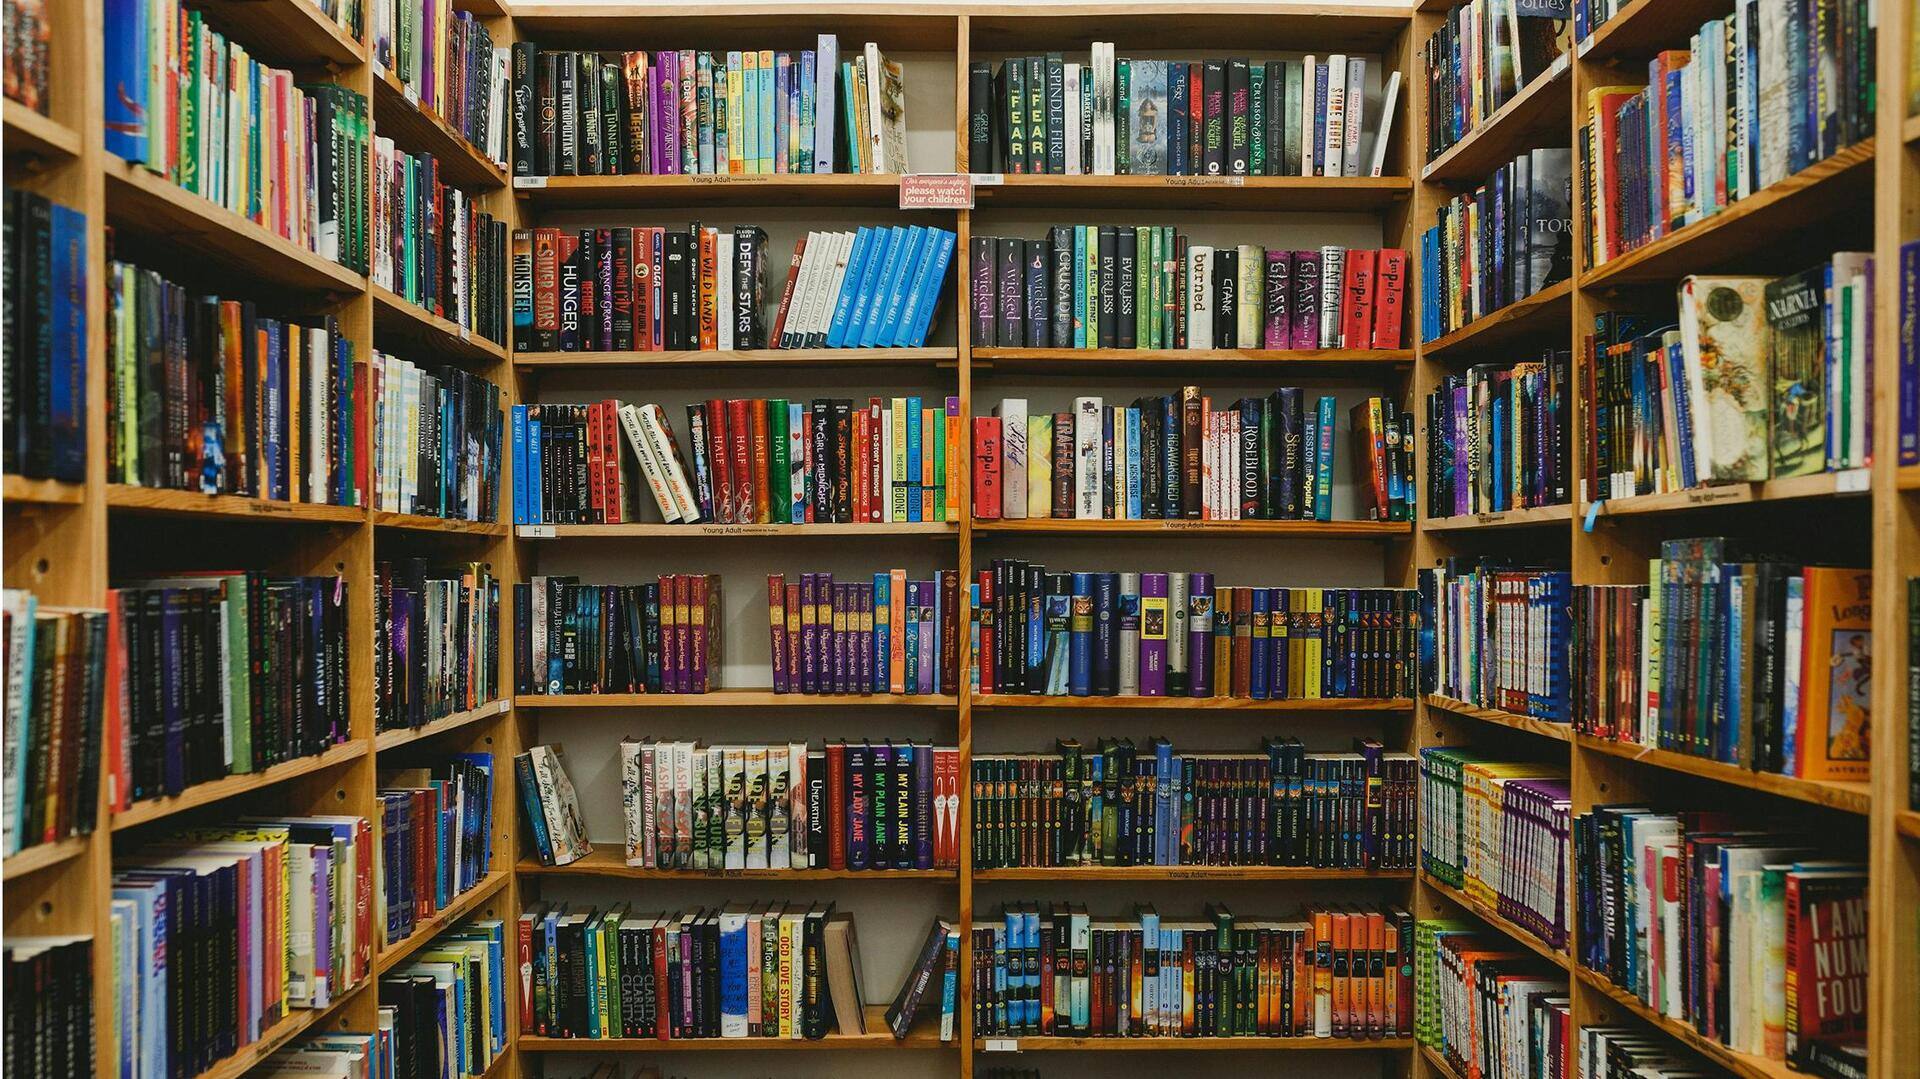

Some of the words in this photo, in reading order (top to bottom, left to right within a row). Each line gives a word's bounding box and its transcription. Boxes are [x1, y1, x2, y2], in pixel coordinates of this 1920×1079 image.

[1050, 67, 1063, 125] SPINDLE
[1119, 75, 1128, 100] ascend
[1252, 82, 1262, 127] CRIMSON
[541, 96, 556, 134] EON
[562, 94, 573, 156] METROPOLITANS
[585, 110, 598, 145] TUNNELS
[604, 110, 619, 156] TUNNELS
[629, 112, 644, 152] DEEPER
[980, 113, 989, 143] GREAT
[1011, 95, 1024, 155] FEAR
[1032, 94, 1044, 154] FEAR
[1050, 130, 1063, 158] FIRE
[1252, 127, 1263, 165] BOUND
[715, 176, 731, 184] Adult
[905, 187, 936, 198] please
[938, 187, 967, 198] watch
[905, 196, 929, 208] your
[931, 195, 969, 206] children.
[538, 249, 555, 288] SILVER
[600, 250, 613, 297] STRANGE
[702, 257, 714, 289] WILD
[738, 243, 752, 276] DEFY
[514, 254, 531, 313] MONSTER
[563, 265, 578, 331] HUNGER
[782, 280, 794, 299] Greek
[979, 267, 994, 319] wicked
[1006, 268, 1021, 319] wicked
[1033, 274, 1048, 319] wicked
[1059, 251, 1071, 321] CRUSADE
[1100, 256, 1114, 314] EVERLESS
[1119, 257, 1133, 315] EVERLESS
[1194, 253, 1207, 312] burned
[1221, 279, 1234, 316] CRANK
[1269, 262, 1288, 315] GLASS
[1298, 261, 1318, 314] GLASS
[1325, 249, 1342, 315] IDENTICAL
[1349, 272, 1369, 318] impulse
[1382, 258, 1401, 305] impulse
[537, 292, 555, 328] STARS
[600, 300, 613, 332] GRACE
[702, 294, 714, 331] LANDS
[739, 292, 752, 332] STARS
[606, 403, 614, 453] PAPER
[816, 432, 827, 453] GIRL
[817, 418, 827, 432] The
[1305, 424, 1314, 463] MISSION
[714, 435, 725, 464] HALF
[736, 435, 747, 464] HALF
[755, 435, 765, 464] HALF
[775, 435, 785, 464] HALF
[977, 440, 998, 487] impulse
[1055, 418, 1074, 480] TRAFFICK
[1167, 433, 1180, 501] REAWAKENED
[1244, 424, 1259, 498] ROSEBLOOD
[1284, 431, 1300, 471] Stain
[608, 467, 617, 516] TOWNS
[816, 463, 829, 509] MIDNIGHT
[895, 487, 906, 514] BOONE
[910, 487, 921, 514] BOONE
[1319, 472, 1329, 496] TREE
[534, 527, 542, 536] H
[703, 527, 724, 535] Young
[726, 526, 742, 534] Adult
[555, 619, 563, 654] BELOVED
[906, 630, 919, 652] River
[906, 652, 918, 677] Secrets
[644, 763, 653, 784] WE'LL
[659, 765, 669, 804] ASHES
[677, 766, 687, 804] ASHES
[853, 774, 863, 788] MY
[875, 773, 886, 788] MY
[898, 773, 908, 788] MY
[644, 785, 653, 811] ALWAYS
[811, 779, 823, 834] UNEARTHLY
[853, 791, 863, 816] LADY
[875, 790, 886, 817] PLAIN
[898, 790, 908, 818] PLAIN
[645, 812, 654, 831] HAVE
[853, 818, 863, 842] JANE
[875, 820, 886, 844] JANE
[898, 820, 908, 845] JANE
[1811, 903, 1819, 940] I
[1831, 899, 1866, 938] AM
[780, 936, 790, 956] OCD
[1814, 938, 1868, 979] NUM
[780, 960, 790, 985] LOVE
[621, 973, 632, 1022] CLARITY
[632, 974, 643, 1023] CLARITY
[644, 973, 656, 1023] CLARITY
[780, 988, 790, 1021] STORY
[1816, 977, 1863, 1018] FOU
